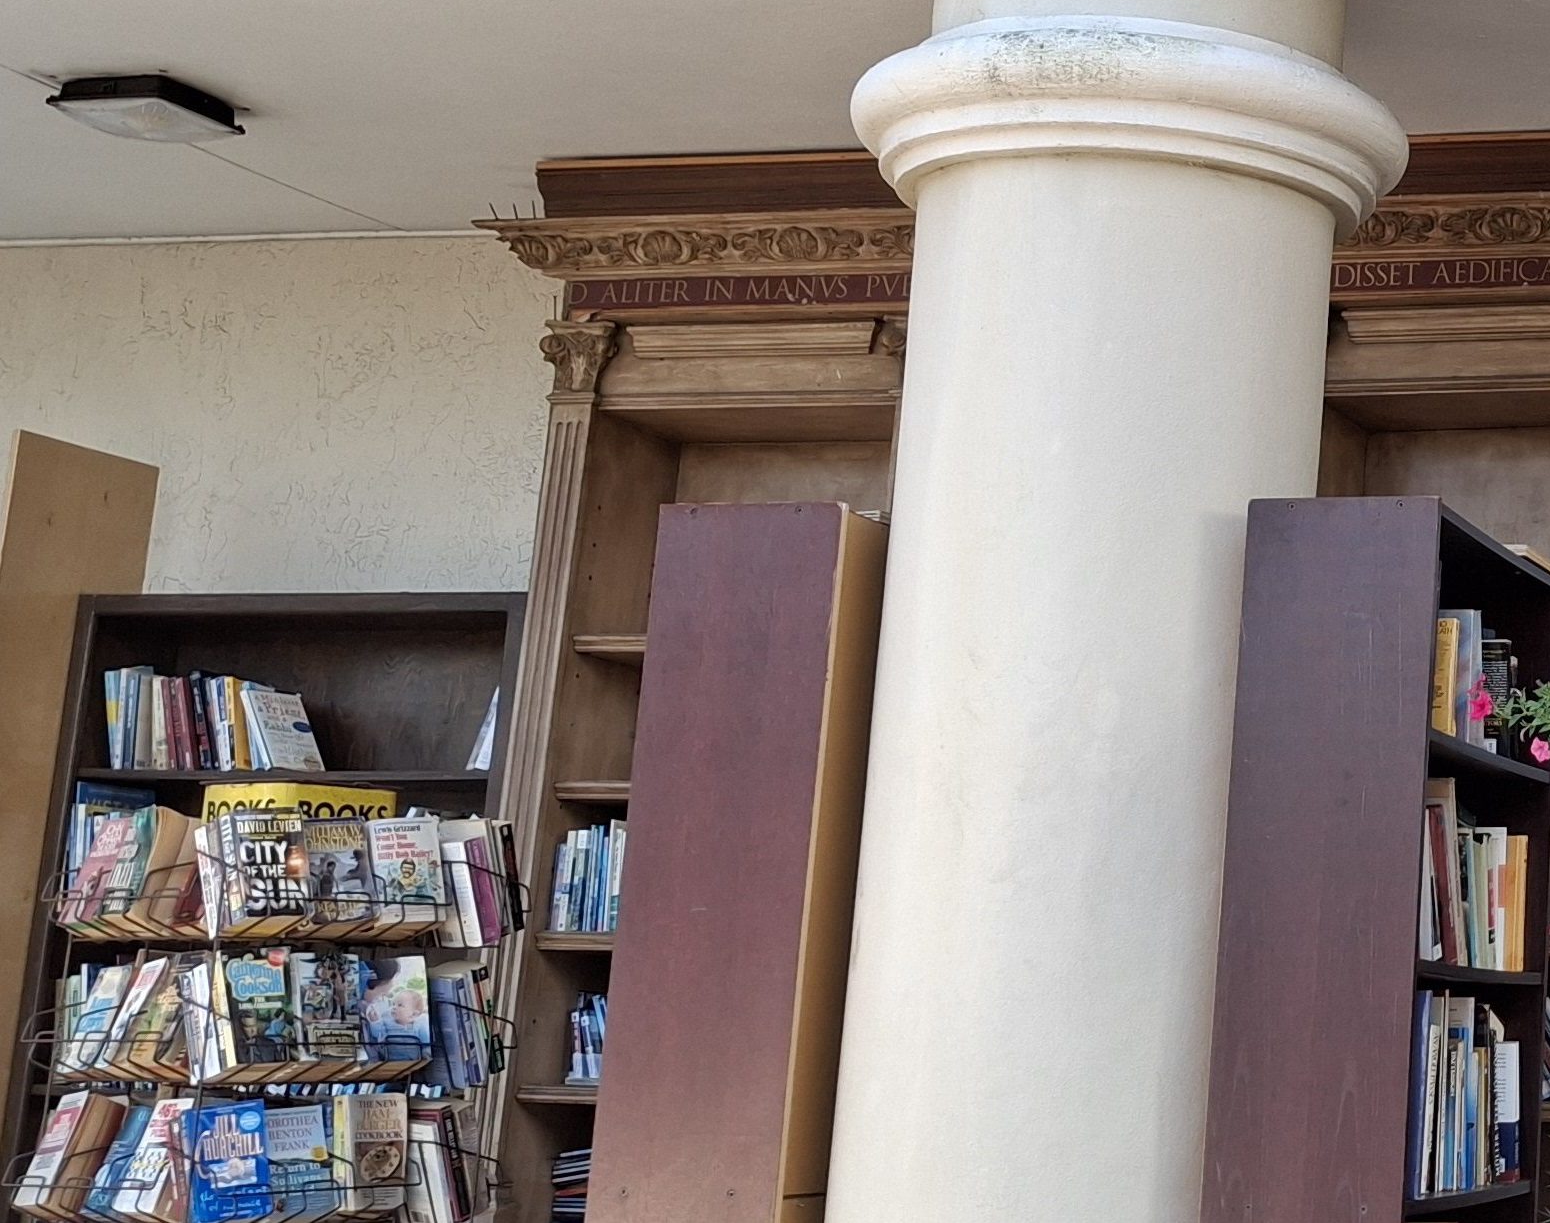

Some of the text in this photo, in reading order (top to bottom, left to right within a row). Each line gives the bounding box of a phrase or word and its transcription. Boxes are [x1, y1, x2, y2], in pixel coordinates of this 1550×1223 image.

[1334, 262, 1421, 288] DISSET
[601, 280, 691, 304] ALITER
[704, 279, 741, 301] IN
[746, 275, 849, 301] MANVS
[237, 819, 301, 834] DAVID LEVIEN
[374, 824, 420, 834] Lewis Grizzard
[305, 837, 365, 849] OHNSTONE
[240, 841, 288, 863] CITY
[245, 865, 286, 877] OF THE
[250, 879, 311, 910] SUN
[236, 978, 283, 998] Cookson
[376, 1099, 398, 1108] NEW
[213, 1113, 240, 1138] JILL
[269, 1128, 312, 1140] BENTON
[274, 1139, 310, 1152] FRANK
[269, 1164, 306, 1174] Reurn
